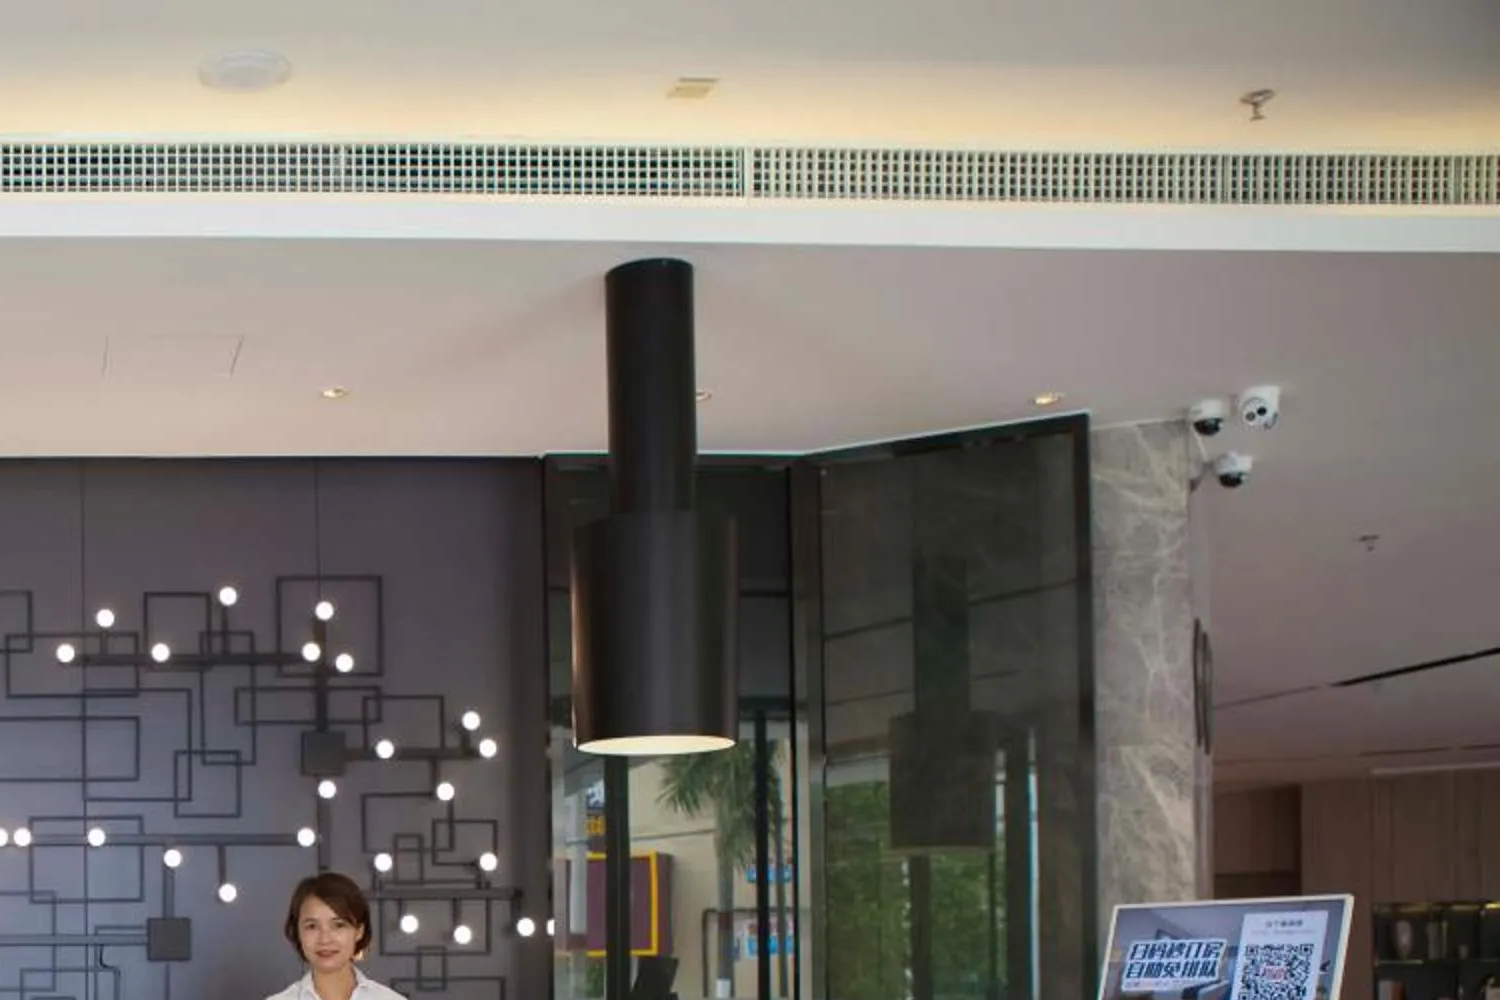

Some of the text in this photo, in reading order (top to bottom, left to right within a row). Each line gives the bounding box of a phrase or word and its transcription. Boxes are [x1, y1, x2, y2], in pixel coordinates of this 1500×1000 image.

[1125, 959, 1219, 979] 自助免排队
